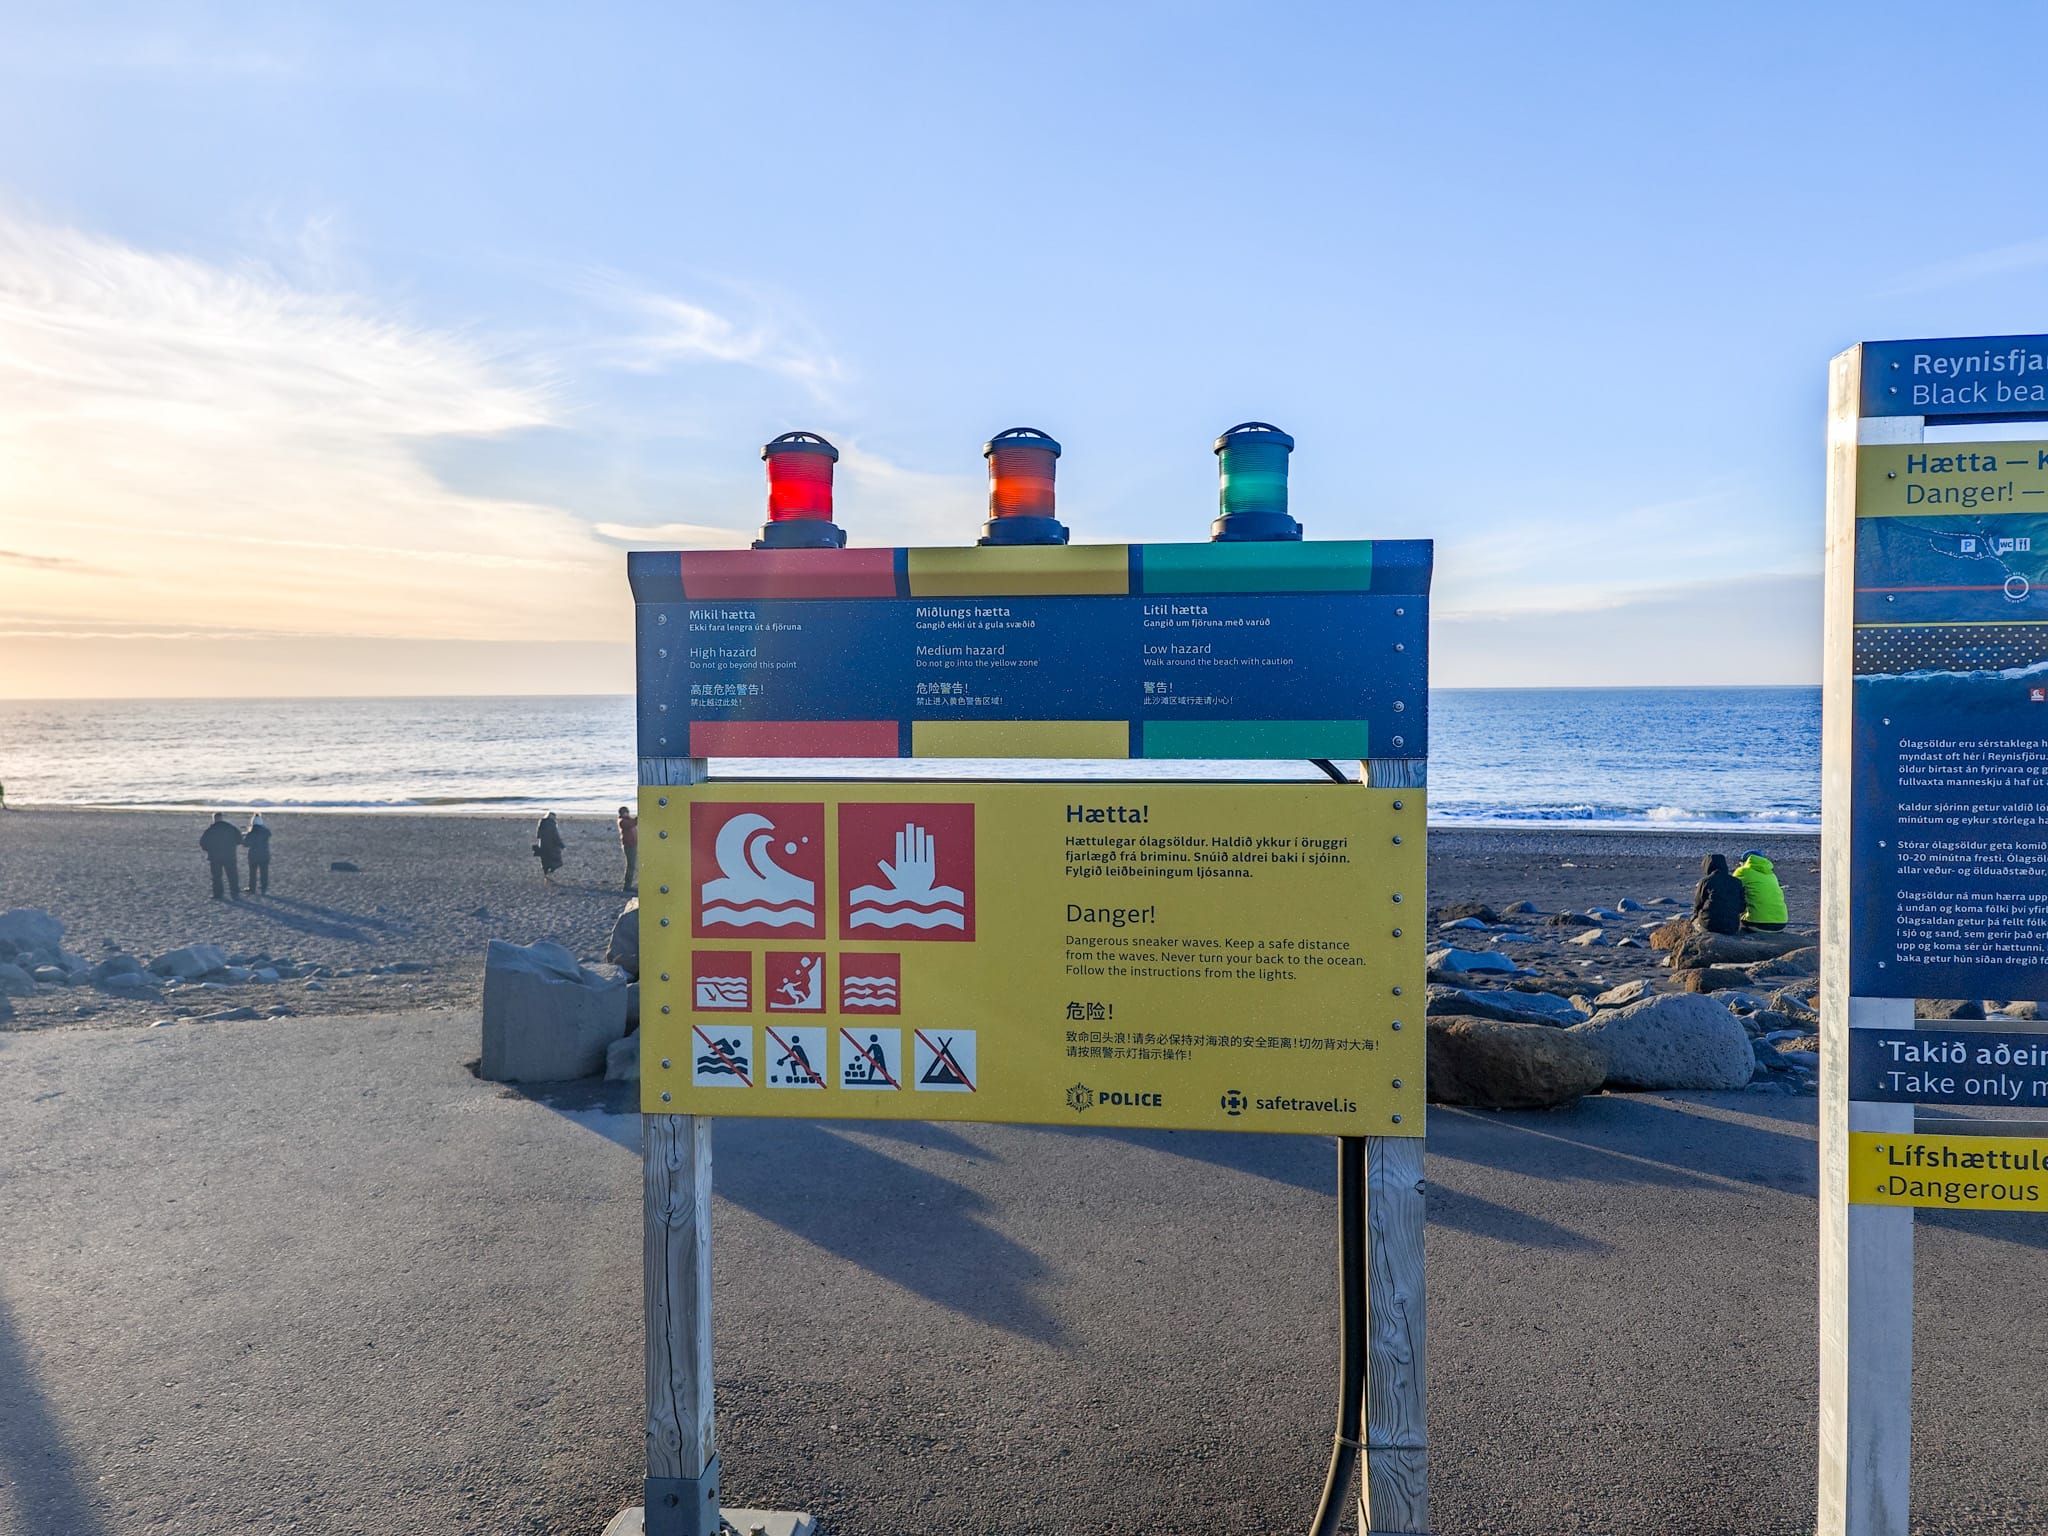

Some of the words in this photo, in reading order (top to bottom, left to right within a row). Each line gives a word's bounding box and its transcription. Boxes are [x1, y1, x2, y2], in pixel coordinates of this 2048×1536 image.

[1913, 349, 2048, 378] Reynisfja
[1913, 381, 1988, 406] Black
[1997, 380, 2046, 402] bea
[1907, 453, 1998, 474] Hætta
[1907, 482, 2013, 508] Danger!
[690, 610, 720, 620] Mikil
[722, 610, 756, 620] hætta
[916, 607, 971, 619] Miðlungs
[975, 607, 1010, 617] hætta
[1144, 605, 1168, 615] Lítil
[1172, 605, 1208, 615] hætta
[727, 624, 753, 632] lengra
[772, 623, 802, 632] fjöruna
[916, 621, 946, 630] Gangið
[985, 621, 1004, 630] gula
[1144, 619, 1174, 628] Gangið
[1192, 619, 1223, 628] fjöruna
[690, 648, 716, 660] High
[719, 647, 757, 657] hazard
[916, 645, 963, 656] Medium
[966, 645, 1005, 655] hazard
[1144, 645, 1168, 654] Low
[1171, 644, 1211, 654] hazard
[730, 661, 758, 670] beyond
[776, 661, 797, 670] point
[990, 659, 1017, 668] yellow
[691, 684, 764, 696] 高度危险警告!
[916, 682, 968, 694] 危险警告!
[1144, 682, 1173, 693] 警告!
[1899, 739, 1956, 749] Ólagsöldur
[1978, 740, 2039, 749] sérstaklega
[1899, 753, 1942, 761] myndast
[1945, 752, 1960, 760] oft
[1963, 752, 1980, 760] hér
[1982, 752, 1985, 760] í
[1988, 752, 2048, 762] Reynisfjöru.
[1898, 765, 1926, 773] öldur
[1966, 765, 1978, 773] án
[1981, 765, 2024, 774] fyrirvara
[2026, 767, 2040, 775] og
[1899, 778, 1944, 786] fullvaxta
[1946, 778, 2002, 787] manneskju
[1898, 803, 1932, 811] Kaldur
[1934, 803, 1970, 812] sjórinn
[2002, 803, 2034, 812] valdið
[1067, 805, 1148, 823] Hætta!
[1962, 816, 1990, 825] eykur
[1992, 816, 2036, 826] stórlega
[2038, 816, 2048, 824] ha
[1066, 837, 1136, 848] Hættulegar
[1139, 836, 1208, 848] ólagsöldur.
[1212, 837, 1253, 847] Haldið
[1256, 837, 1291, 849] ykkur
[1295, 837, 1298, 847] í
[1301, 838, 1347, 850] öruggri
[1932, 841, 1988, 851] ólagsöldur
[1990, 843, 2013, 851] geta
[2016, 842, 2047, 850] komið
[1066, 851, 1117, 864] fjarlægð
[1120, 851, 1137, 861] frá
[1140, 852, 1190, 862] briminu.
[1194, 852, 1229, 862] Snúið
[1232, 852, 1268, 862] aldrei
[1271, 852, 1298, 863] baki
[1302, 852, 1305, 863] í
[1309, 853, 1350, 865] sjóinn.
[1898, 854, 1927, 862] 10-20
[1929, 854, 1972, 862] mínútna
[1974, 854, 2004, 862] fresti.
[2007, 854, 2048, 864] Ólagsöl
[1066, 866, 1102, 878] Fylgið
[1106, 866, 1193, 879] leiðbeiningum
[1197, 867, 1253, 879] ljósanna.
[1923, 866, 1955, 874] veður-
[1973, 867, 2047, 876] ölduaðstæður,
[1067, 905, 1155, 927] Danger!
[1066, 936, 1129, 948] Dangerous
[1132, 937, 1178, 947] sneaker
[1182, 940, 1222, 948] waves.
[1225, 938, 1255, 950] Keep
[1258, 941, 1265, 949] a
[1269, 939, 1295, 949] safe
[1298, 940, 1350, 950] distance
[1066, 950, 1093, 960] from
[1097, 951, 1115, 961] the
[1119, 953, 1158, 962] waves.
[1161, 952, 1195, 962] Never
[1199, 954, 1223, 963] turn
[1226, 956, 1252, 965] your
[1256, 954, 1284, 964] back
[1288, 955, 1300, 965] to
[1304, 955, 1324, 965] the
[1327, 957, 1366, 966] ocean.
[1066, 965, 1105, 975] Follow
[1108, 966, 1127, 976] the
[1131, 967, 1201, 977] instructions
[1205, 968, 1233, 978] from
[1236, 968, 1256, 979] the
[1259, 969, 1296, 980] lights.
[1066, 1002, 1113, 1020] 危险!
[1066, 1032, 1379, 1050] 致命回头浪!请务必保持对海浪的安全距离!切勿背对大海!
[1066, 1046, 1192, 1060] 请按照警示灯指示操作!
[1887, 1040, 1967, 1064] Takið
[1888, 1071, 1955, 1094] Take
[1964, 1074, 2023, 1101] only
[1099, 1092, 1162, 1106] POLICE
[1256, 1097, 1357, 1112] safetravel.is
[1889, 1176, 2039, 1203] Dangerous
